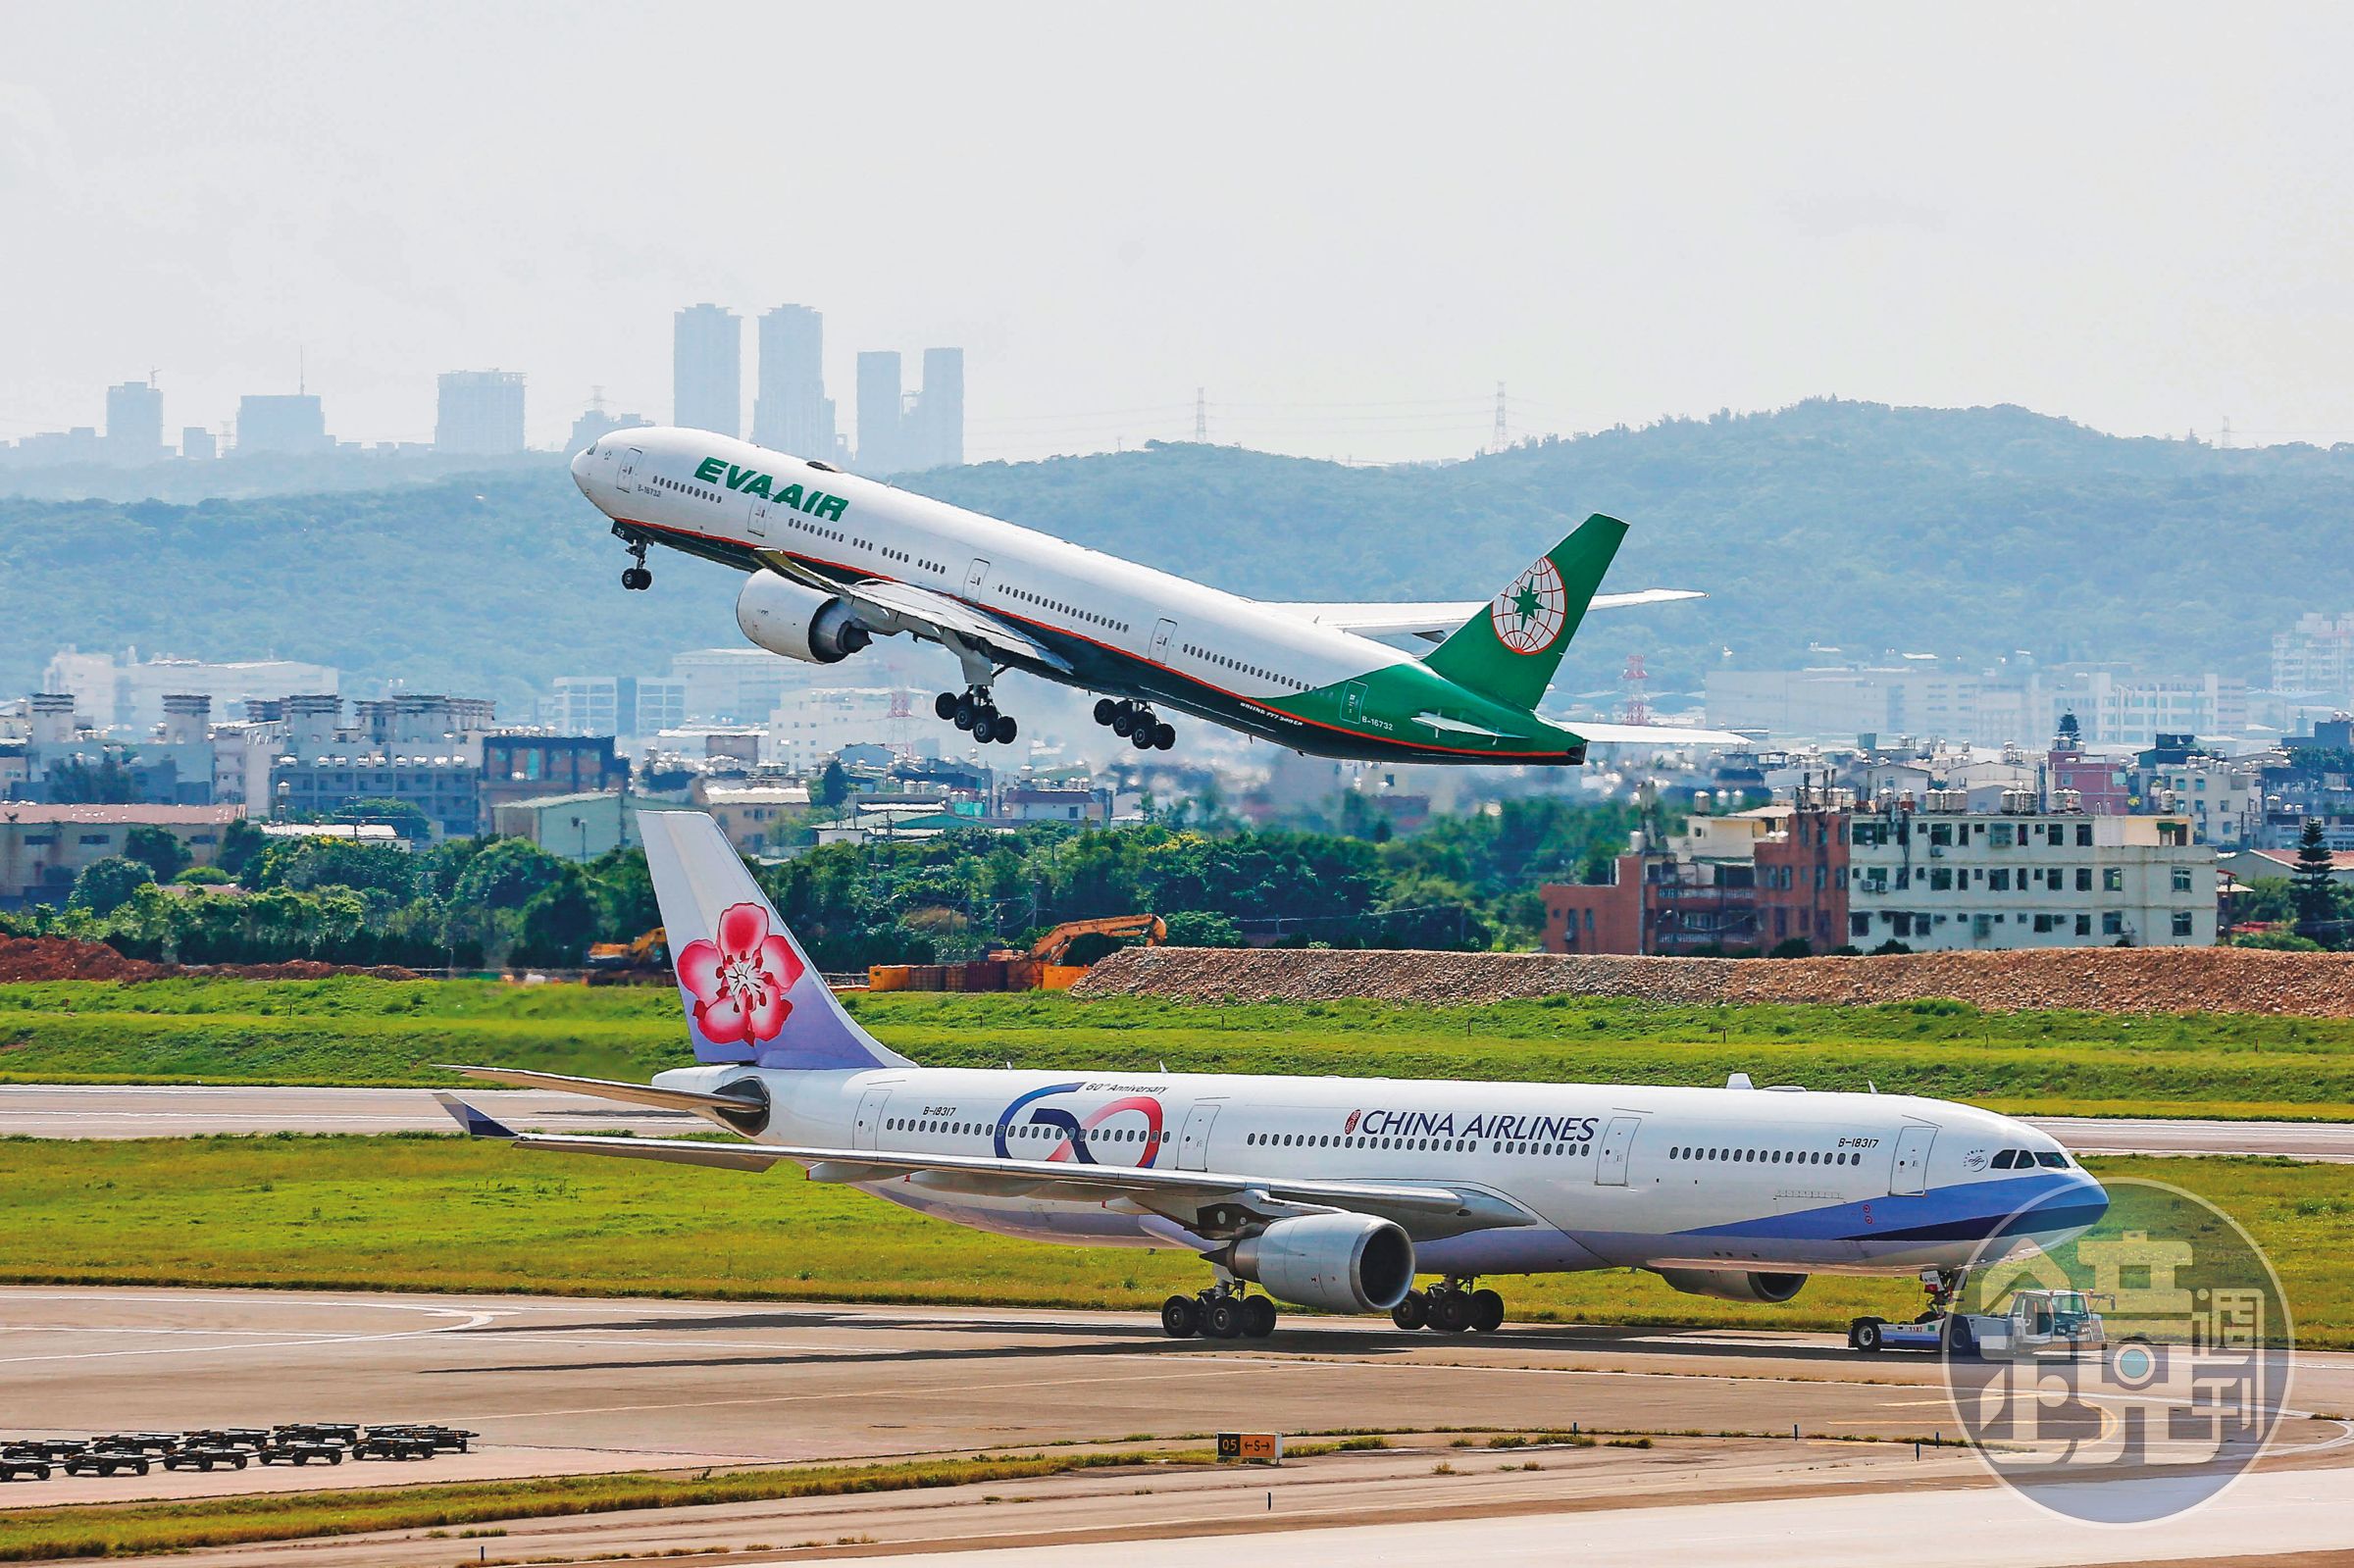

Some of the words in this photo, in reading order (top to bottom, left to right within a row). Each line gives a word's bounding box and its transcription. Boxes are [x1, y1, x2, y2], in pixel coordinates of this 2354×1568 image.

[1361, 715, 1393, 731] B-16732
[1106, 1085, 1168, 1094] Anniversary
[923, 1106, 956, 1116] B-18317
[1362, 1110, 1454, 1137] CHINA
[1460, 1114, 1600, 1141] AIRLINES
[1838, 1138, 1879, 1148] B-18317
